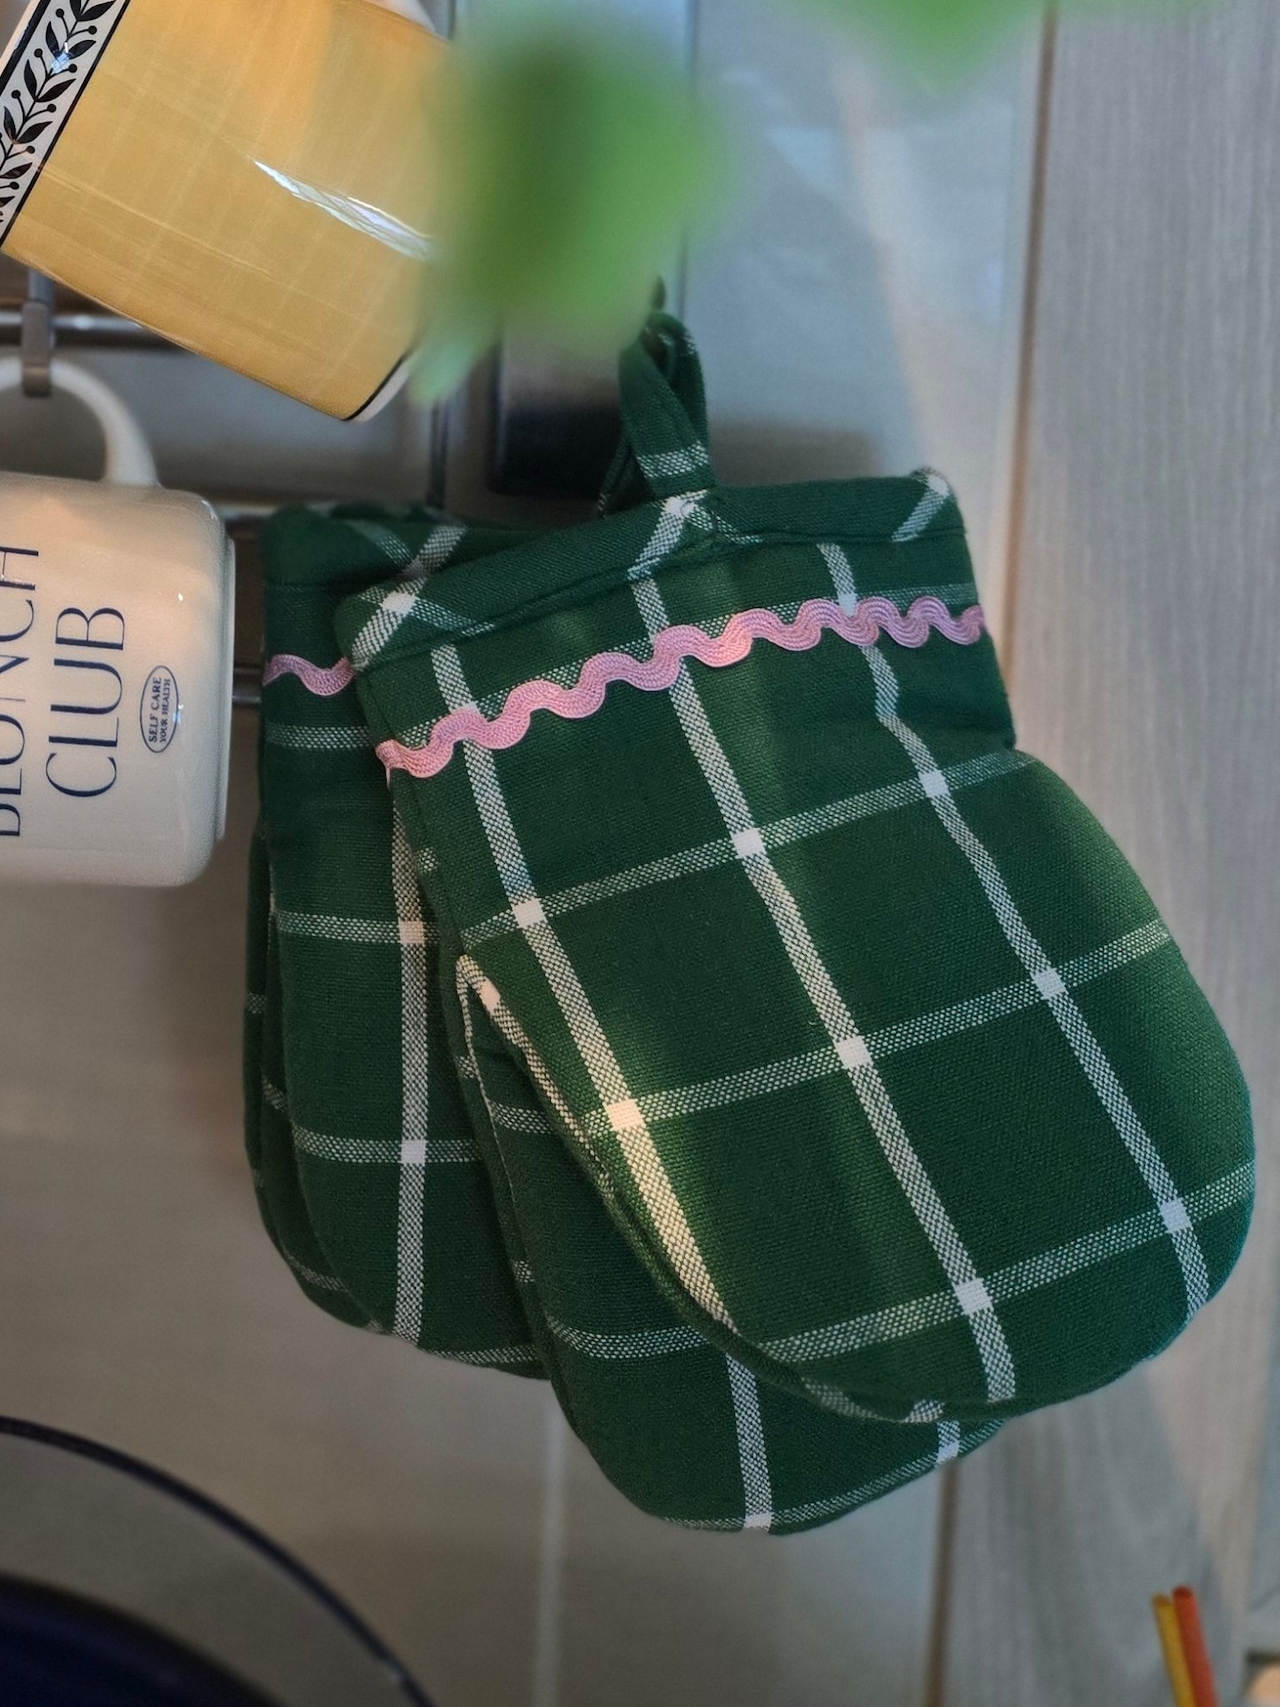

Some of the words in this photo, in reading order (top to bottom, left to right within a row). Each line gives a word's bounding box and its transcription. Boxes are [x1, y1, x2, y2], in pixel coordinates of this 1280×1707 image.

[45, 606, 126, 798] CLUB
[150, 677, 162, 710] CARE
[161, 678, 171, 715] HEALTH
[149, 714, 159, 743] SELF
[159, 718, 169, 743] YOUR
